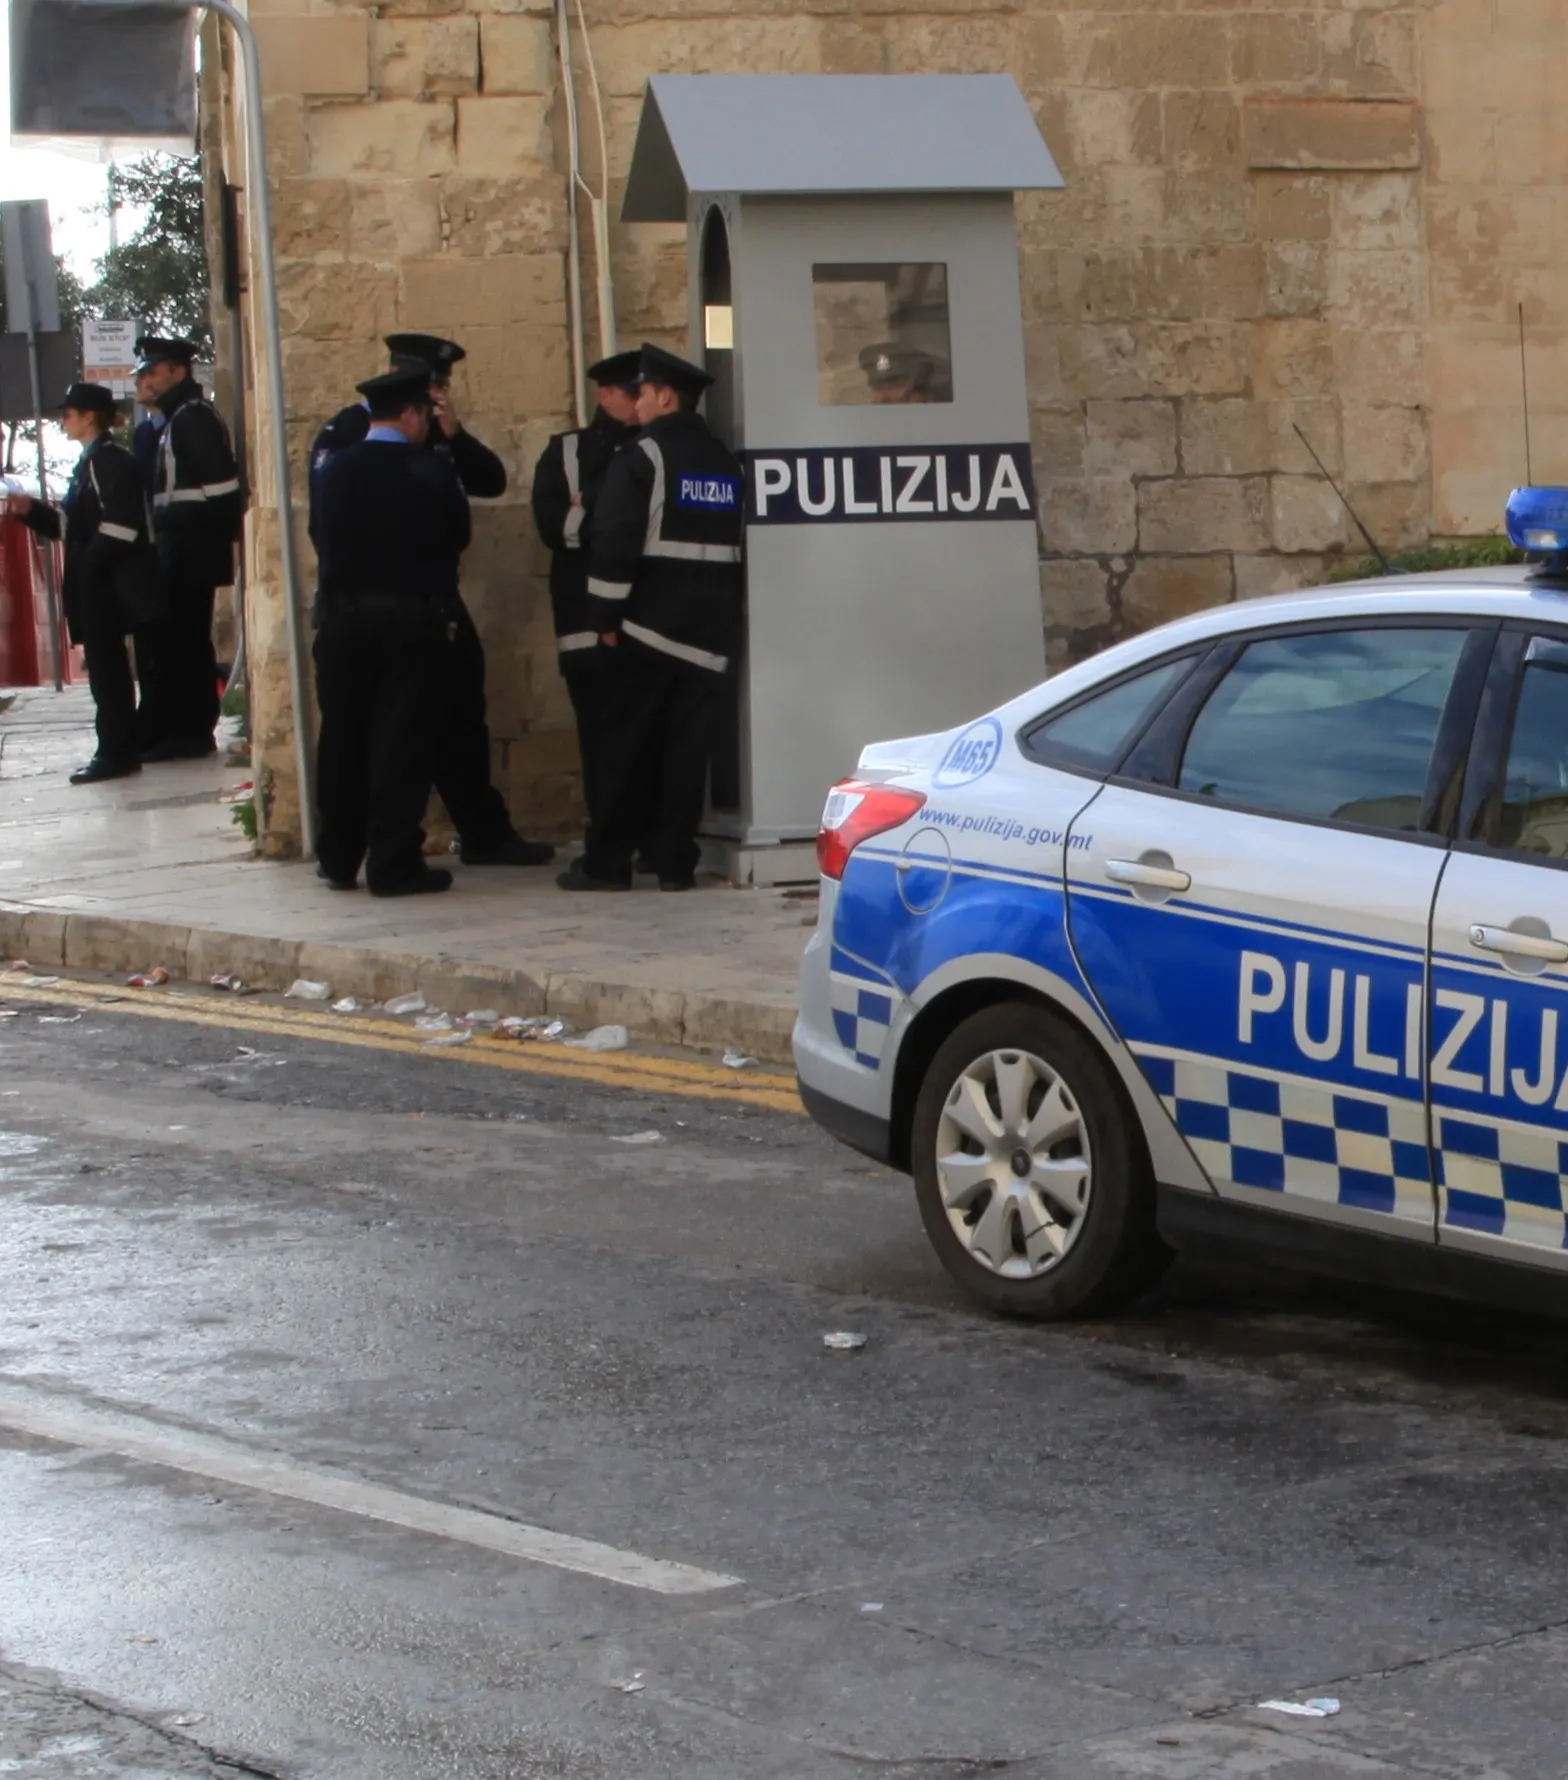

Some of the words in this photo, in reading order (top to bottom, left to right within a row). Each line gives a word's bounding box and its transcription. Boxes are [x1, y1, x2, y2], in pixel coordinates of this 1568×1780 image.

[681, 479, 735, 505] PULIZIJA
[754, 453, 1031, 517] PULIZIJA
[944, 739, 995, 776] M65
[919, 807, 1094, 851] www.pulizija.gov.mt
